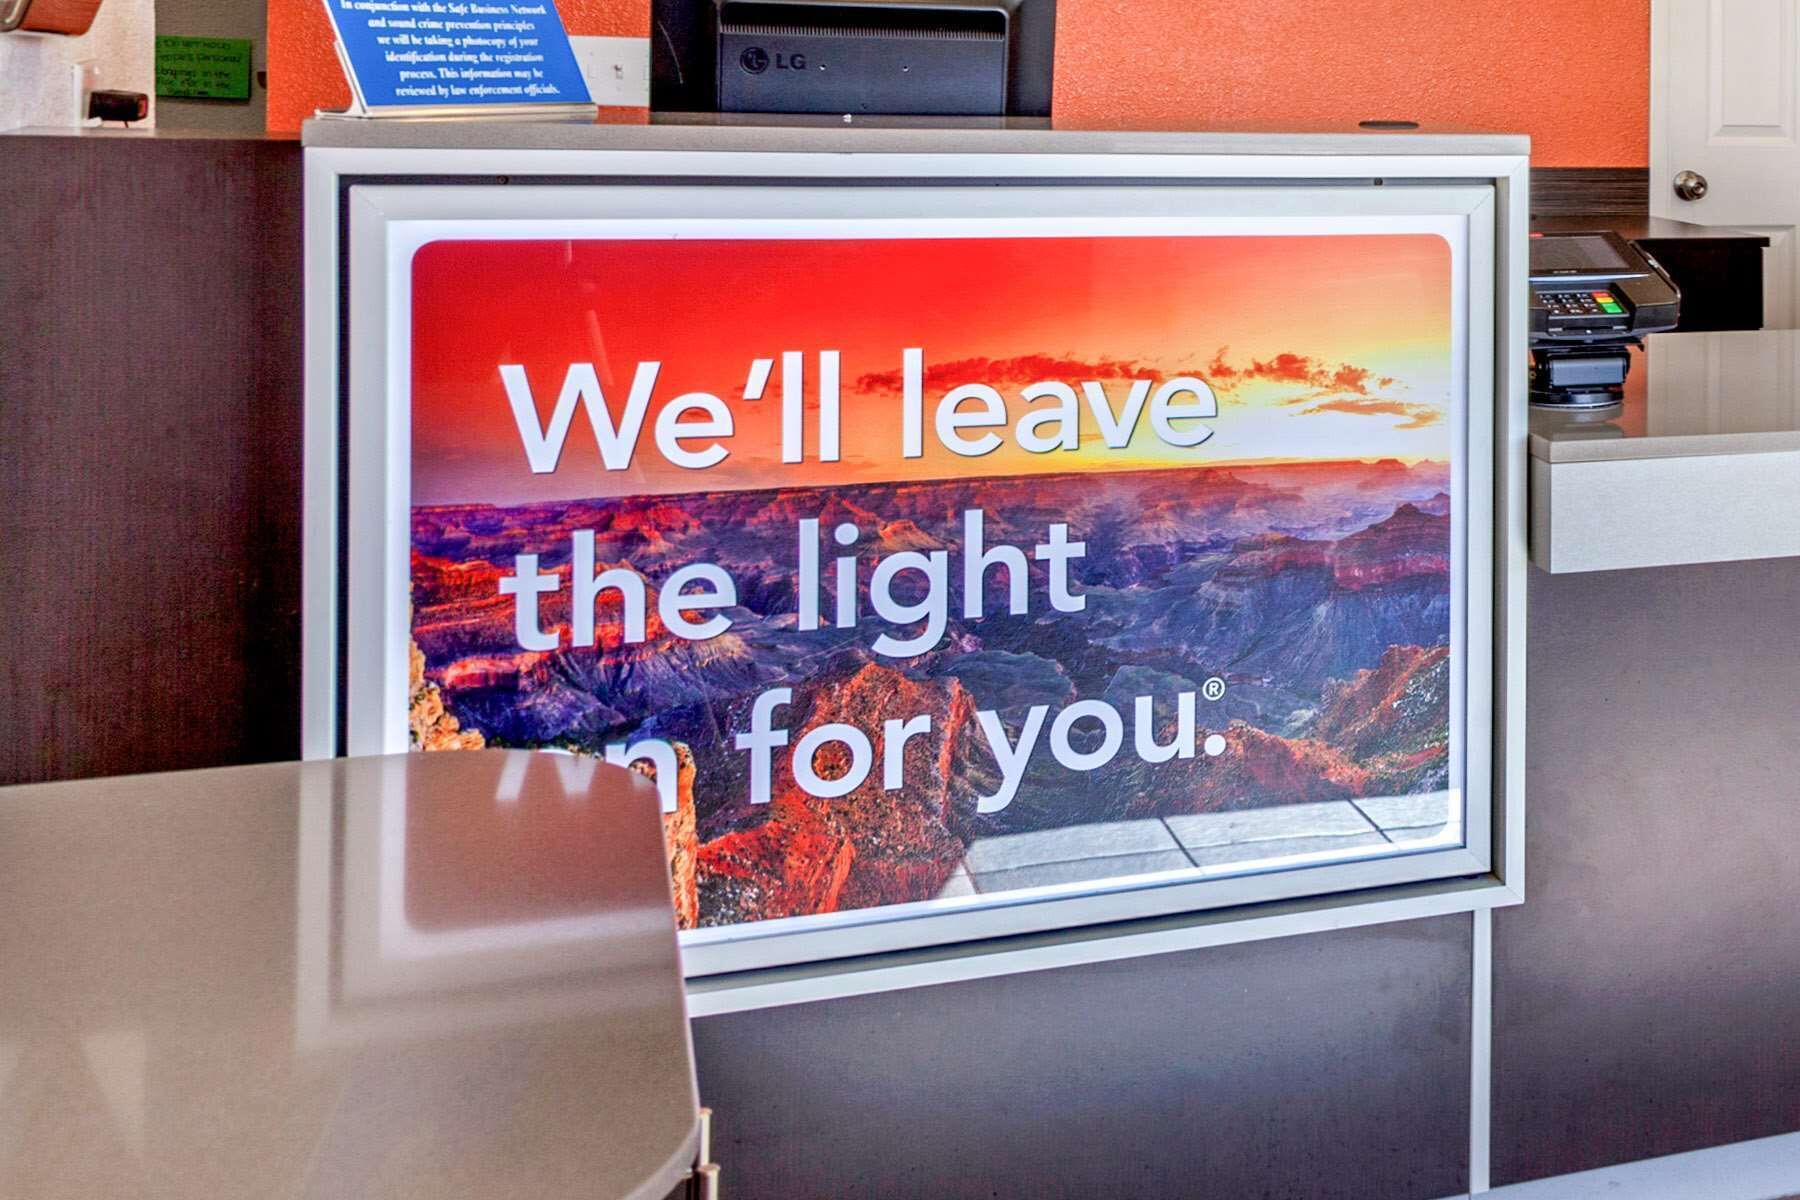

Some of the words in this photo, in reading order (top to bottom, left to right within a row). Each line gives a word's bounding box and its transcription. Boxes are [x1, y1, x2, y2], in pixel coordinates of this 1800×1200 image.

[354, 0, 410, 13] conjunction
[410, 2, 431, 12] with
[432, 3, 447, 13] the
[448, 3, 469, 16] Safe
[470, 3, 509, 14] Business
[510, 4, 547, 14] Network
[368, 16, 386, 28] and
[387, 18, 416, 28] sound
[417, 19, 443, 29] crime
[445, 20, 492, 32] prevention
[493, 20, 535, 32] principles
[376, 36, 390, 45] we
[391, 33, 410, 45] will
[411, 34, 423, 45] be
[424, 35, 454, 48] taking
[454, 38, 462, 46] a
[462, 35, 506, 48] photocopy
[508, 36, 518, 48] of
[519, 38, 538, 48] your
[385, 51, 447, 64] identification
[448, 51, 479, 64] during
[480, 52, 494, 62] the
[495, 52, 544, 64] registration
[775, 53, 806, 69] LG
[399, 71, 437, 82] process.
[438, 68, 460, 78] This
[460, 68, 513, 81] information
[514, 71, 532, 81] may
[532, 67, 544, 78] be
[395, 85, 437, 96] reviewed
[437, 84, 449, 99] by
[450, 84, 467, 95] law
[468, 84, 523, 97] enforcement
[902, 347, 1218, 459] leave
[499, 528, 737, 652] the
[797, 509, 1087, 658] light
[735, 687, 932, 804] for
